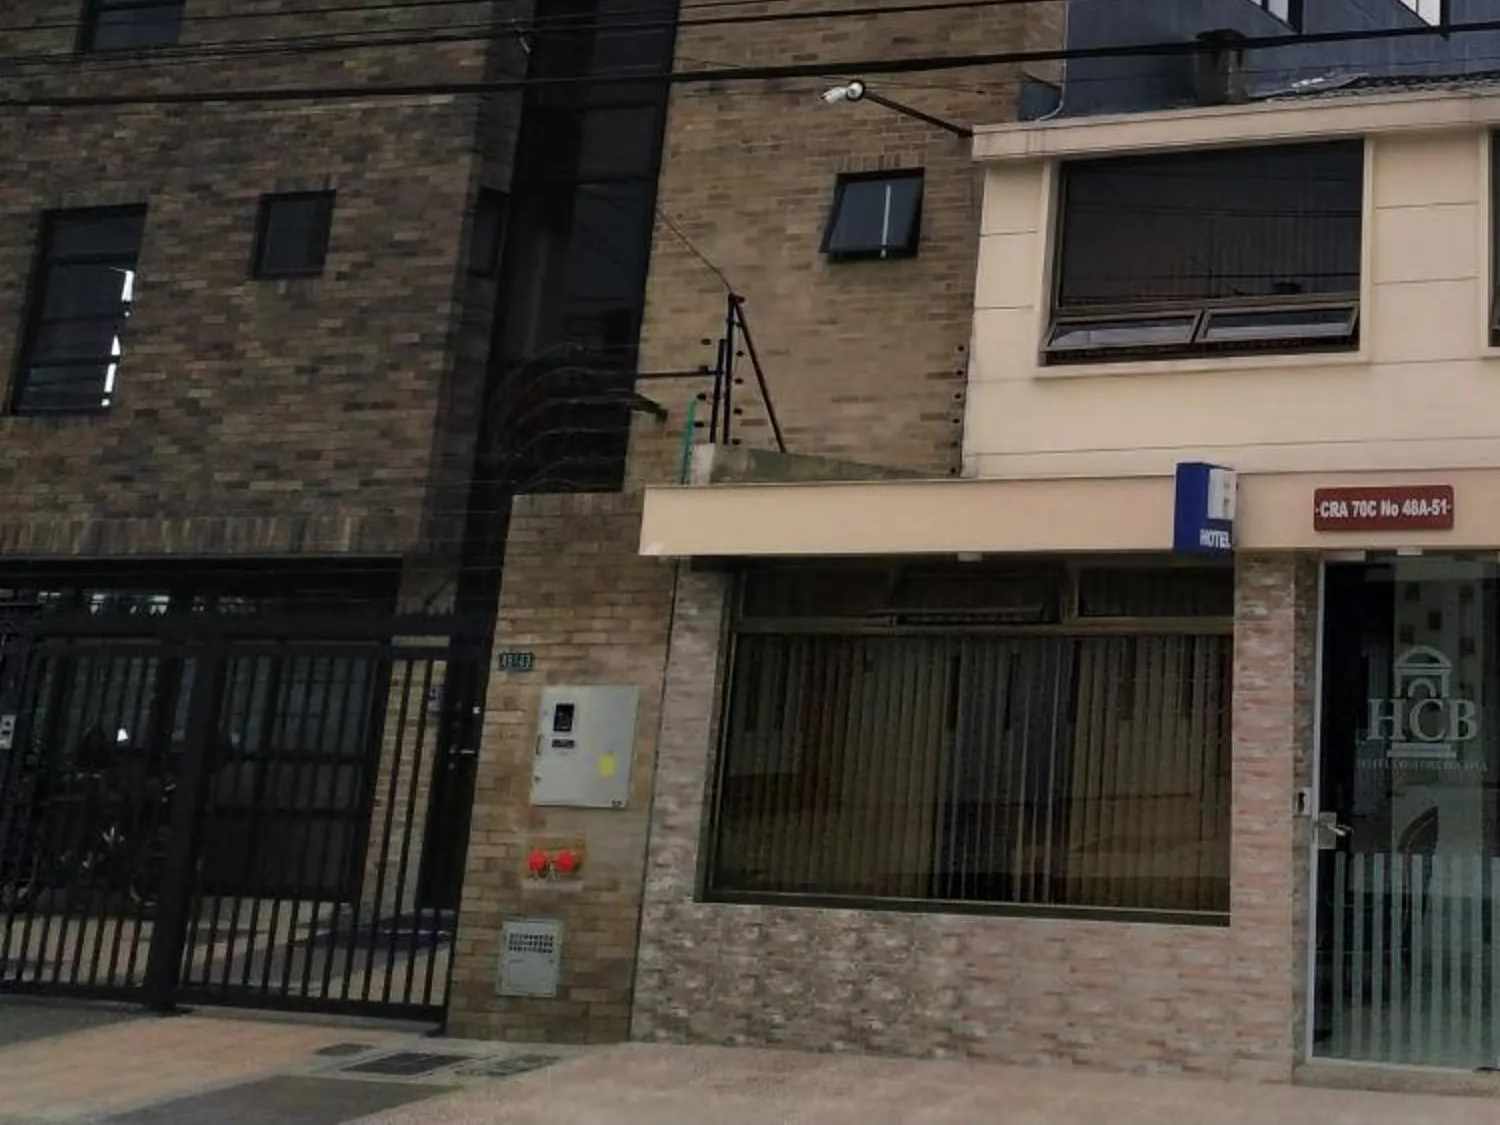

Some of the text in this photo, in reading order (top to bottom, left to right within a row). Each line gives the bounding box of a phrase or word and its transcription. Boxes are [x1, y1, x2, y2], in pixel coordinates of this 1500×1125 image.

[1320, 498, 1447, 517] CRA 70C No 48A-51
[1200, 528, 1230, 548] HOTEL
[1366, 698, 1478, 740] HCB
